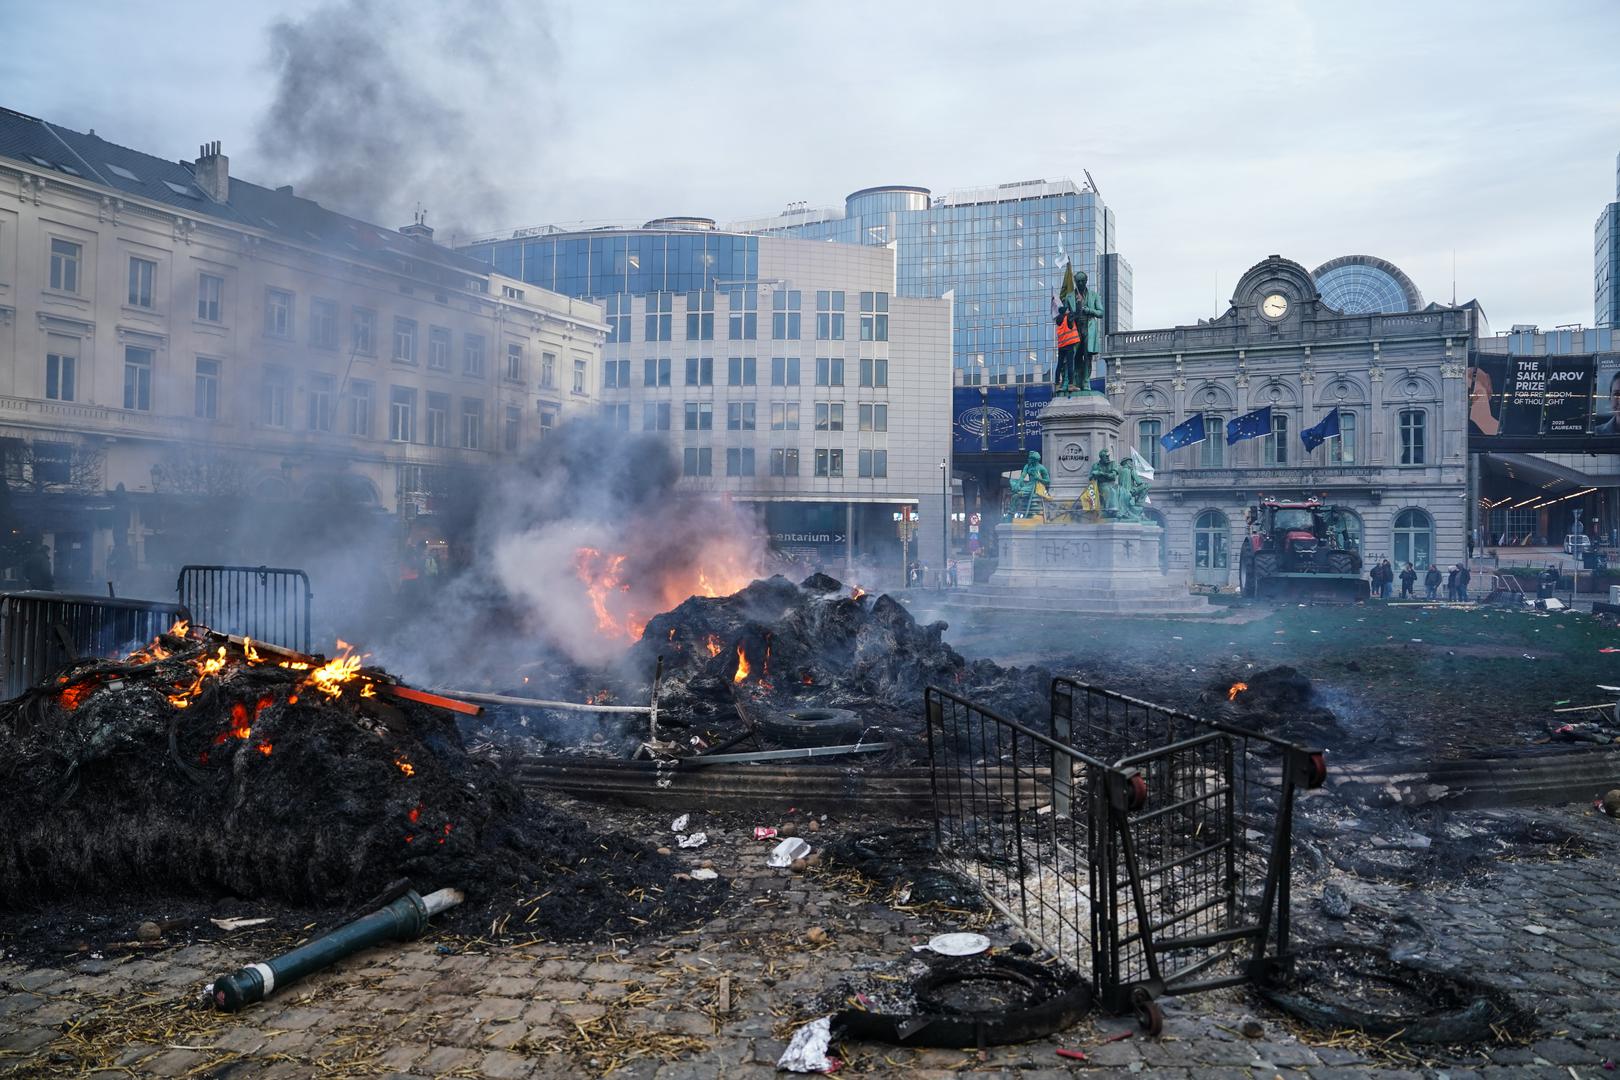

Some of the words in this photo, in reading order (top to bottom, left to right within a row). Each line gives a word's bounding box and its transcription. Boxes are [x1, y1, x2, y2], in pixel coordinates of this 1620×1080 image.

[1518, 362, 1539, 371] THE
[1516, 381, 1545, 390] PRIZE
[1024, 400, 1048, 408] Europ
[1025, 419, 1042, 427] Euro
[1026, 428, 1042, 436] Parl
[776, 532, 830, 542] entarium
